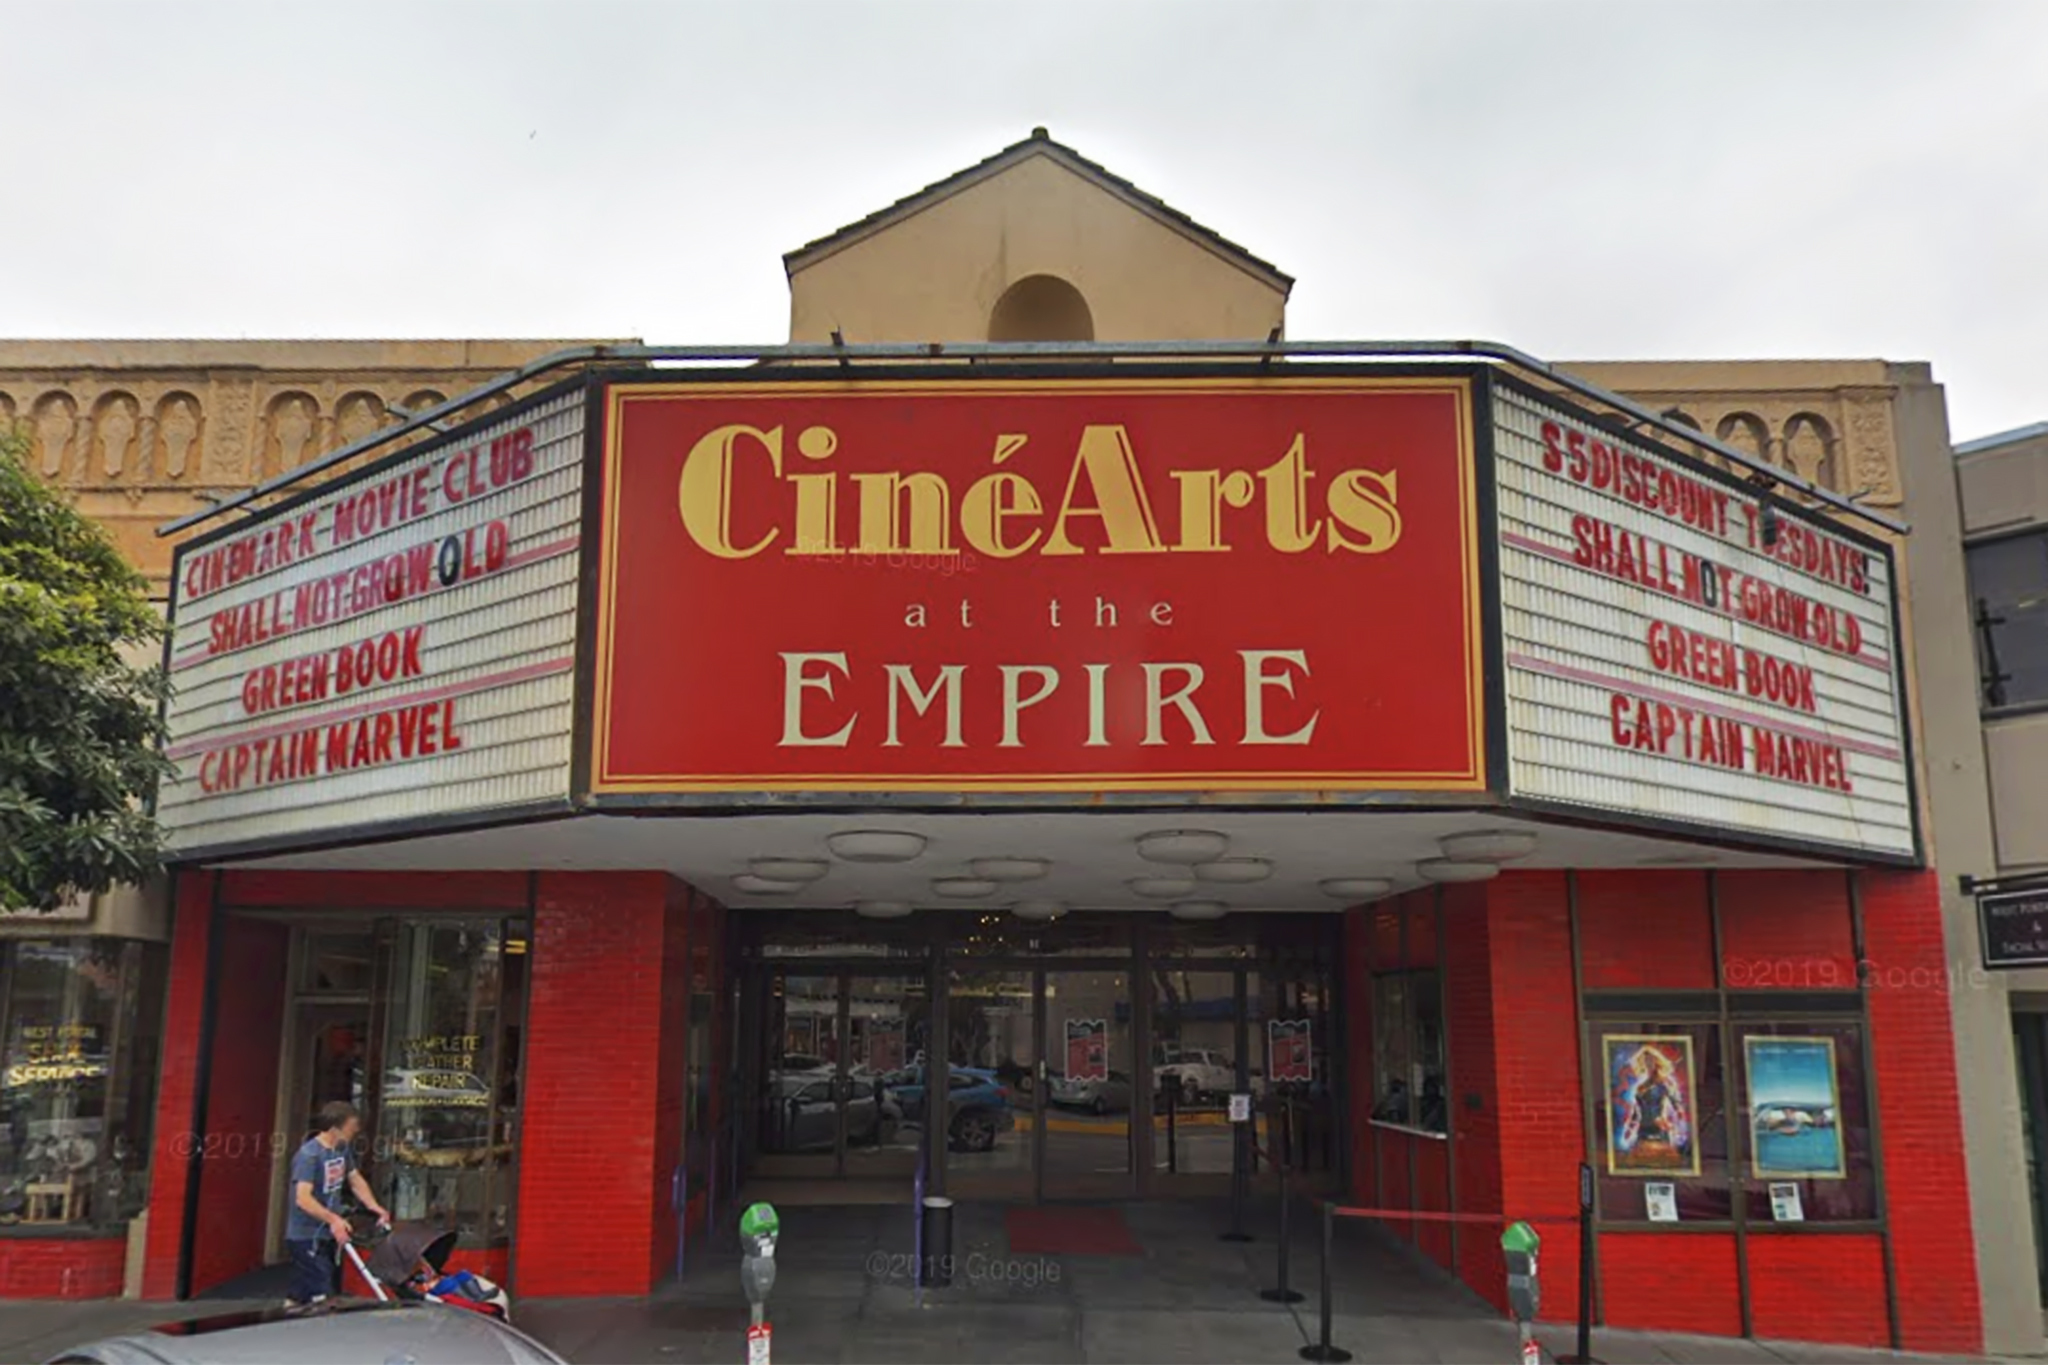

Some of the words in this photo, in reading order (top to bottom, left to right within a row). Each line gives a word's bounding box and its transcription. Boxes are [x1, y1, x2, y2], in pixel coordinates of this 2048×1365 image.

[186, 512, 317, 598] CINEMARK
[333, 466, 432, 546] MOVIE
[444, 427, 534, 502] CLUB
[678, 423, 1402, 559] CinéArts
[209, 592, 288, 654] SHALL
[294, 573, 348, 630] NOT
[352, 543, 435, 615] GROW
[437, 519, 508, 587] OLD
[1572, 514, 1677, 594] SHALL
[1682, 552, 1732, 612] NOT
[1740, 575, 1808, 640] GROW
[1813, 603, 1862, 655] OLD
[1742, 502, 1870, 595] TESDAYS!
[905, 598, 974, 628] at
[1049, 596, 1175, 628] the
[241, 652, 328, 715] GREEN
[335, 624, 425, 693] BOOK
[776, 648, 1321, 748] EMPIRE
[1648, 620, 1738, 690] GREEN
[1745, 641, 1816, 712] BOOK
[199, 729, 318, 793] CAPTAIN
[327, 700, 461, 772] MARVEL
[1610, 694, 1744, 769] CAPTAIN
[1753, 729, 1852, 792] MARVEL
